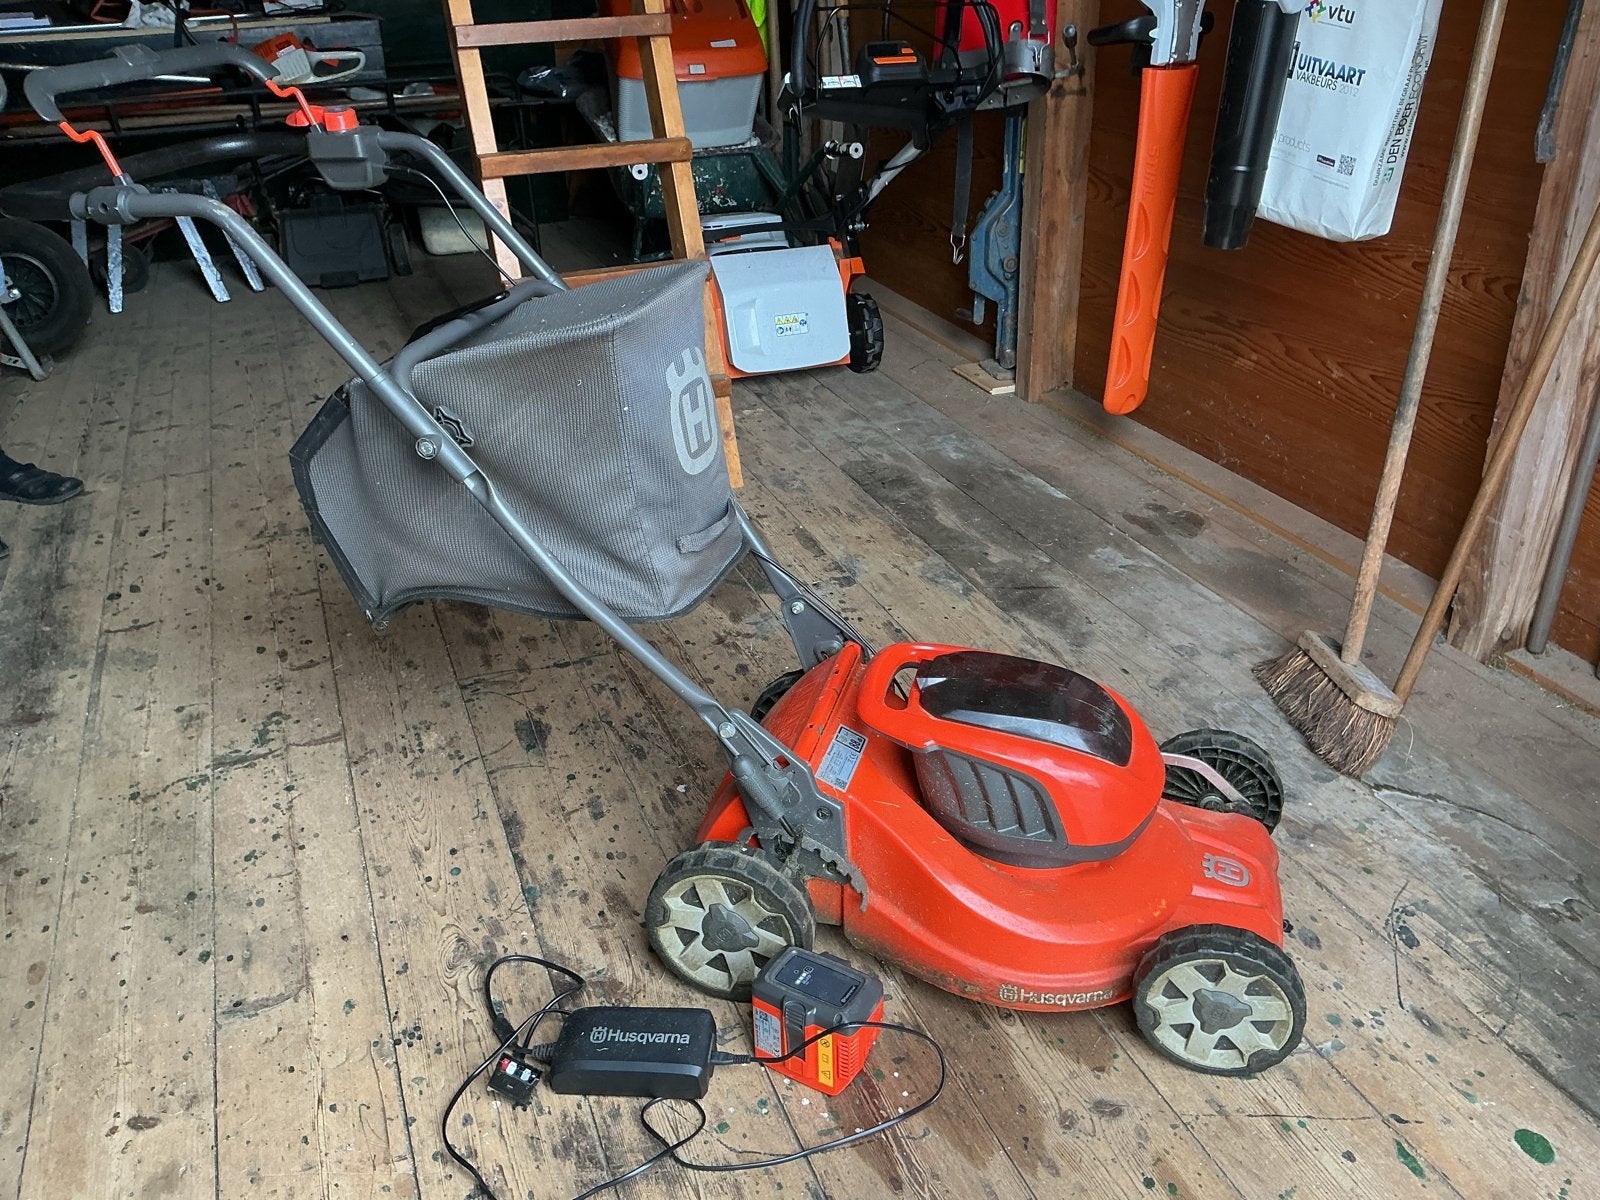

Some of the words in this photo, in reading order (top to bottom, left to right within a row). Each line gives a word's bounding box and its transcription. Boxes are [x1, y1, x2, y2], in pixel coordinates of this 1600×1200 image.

[1328, 4, 1355, 24] vtu
[1298, 53, 1366, 86] UITVAART
[1296, 70, 1338, 91] VAKBEURS
[1338, 83, 1360, 97] 2012
[1386, 138, 1402, 164] DEN
[1394, 101, 1415, 136] BOER
[1277, 133, 1311, 153] products
[1143, 145, 1159, 198] STIHL
[1020, 988, 1114, 1006] Husqvarna
[607, 1028, 690, 1045] Husqvarna
